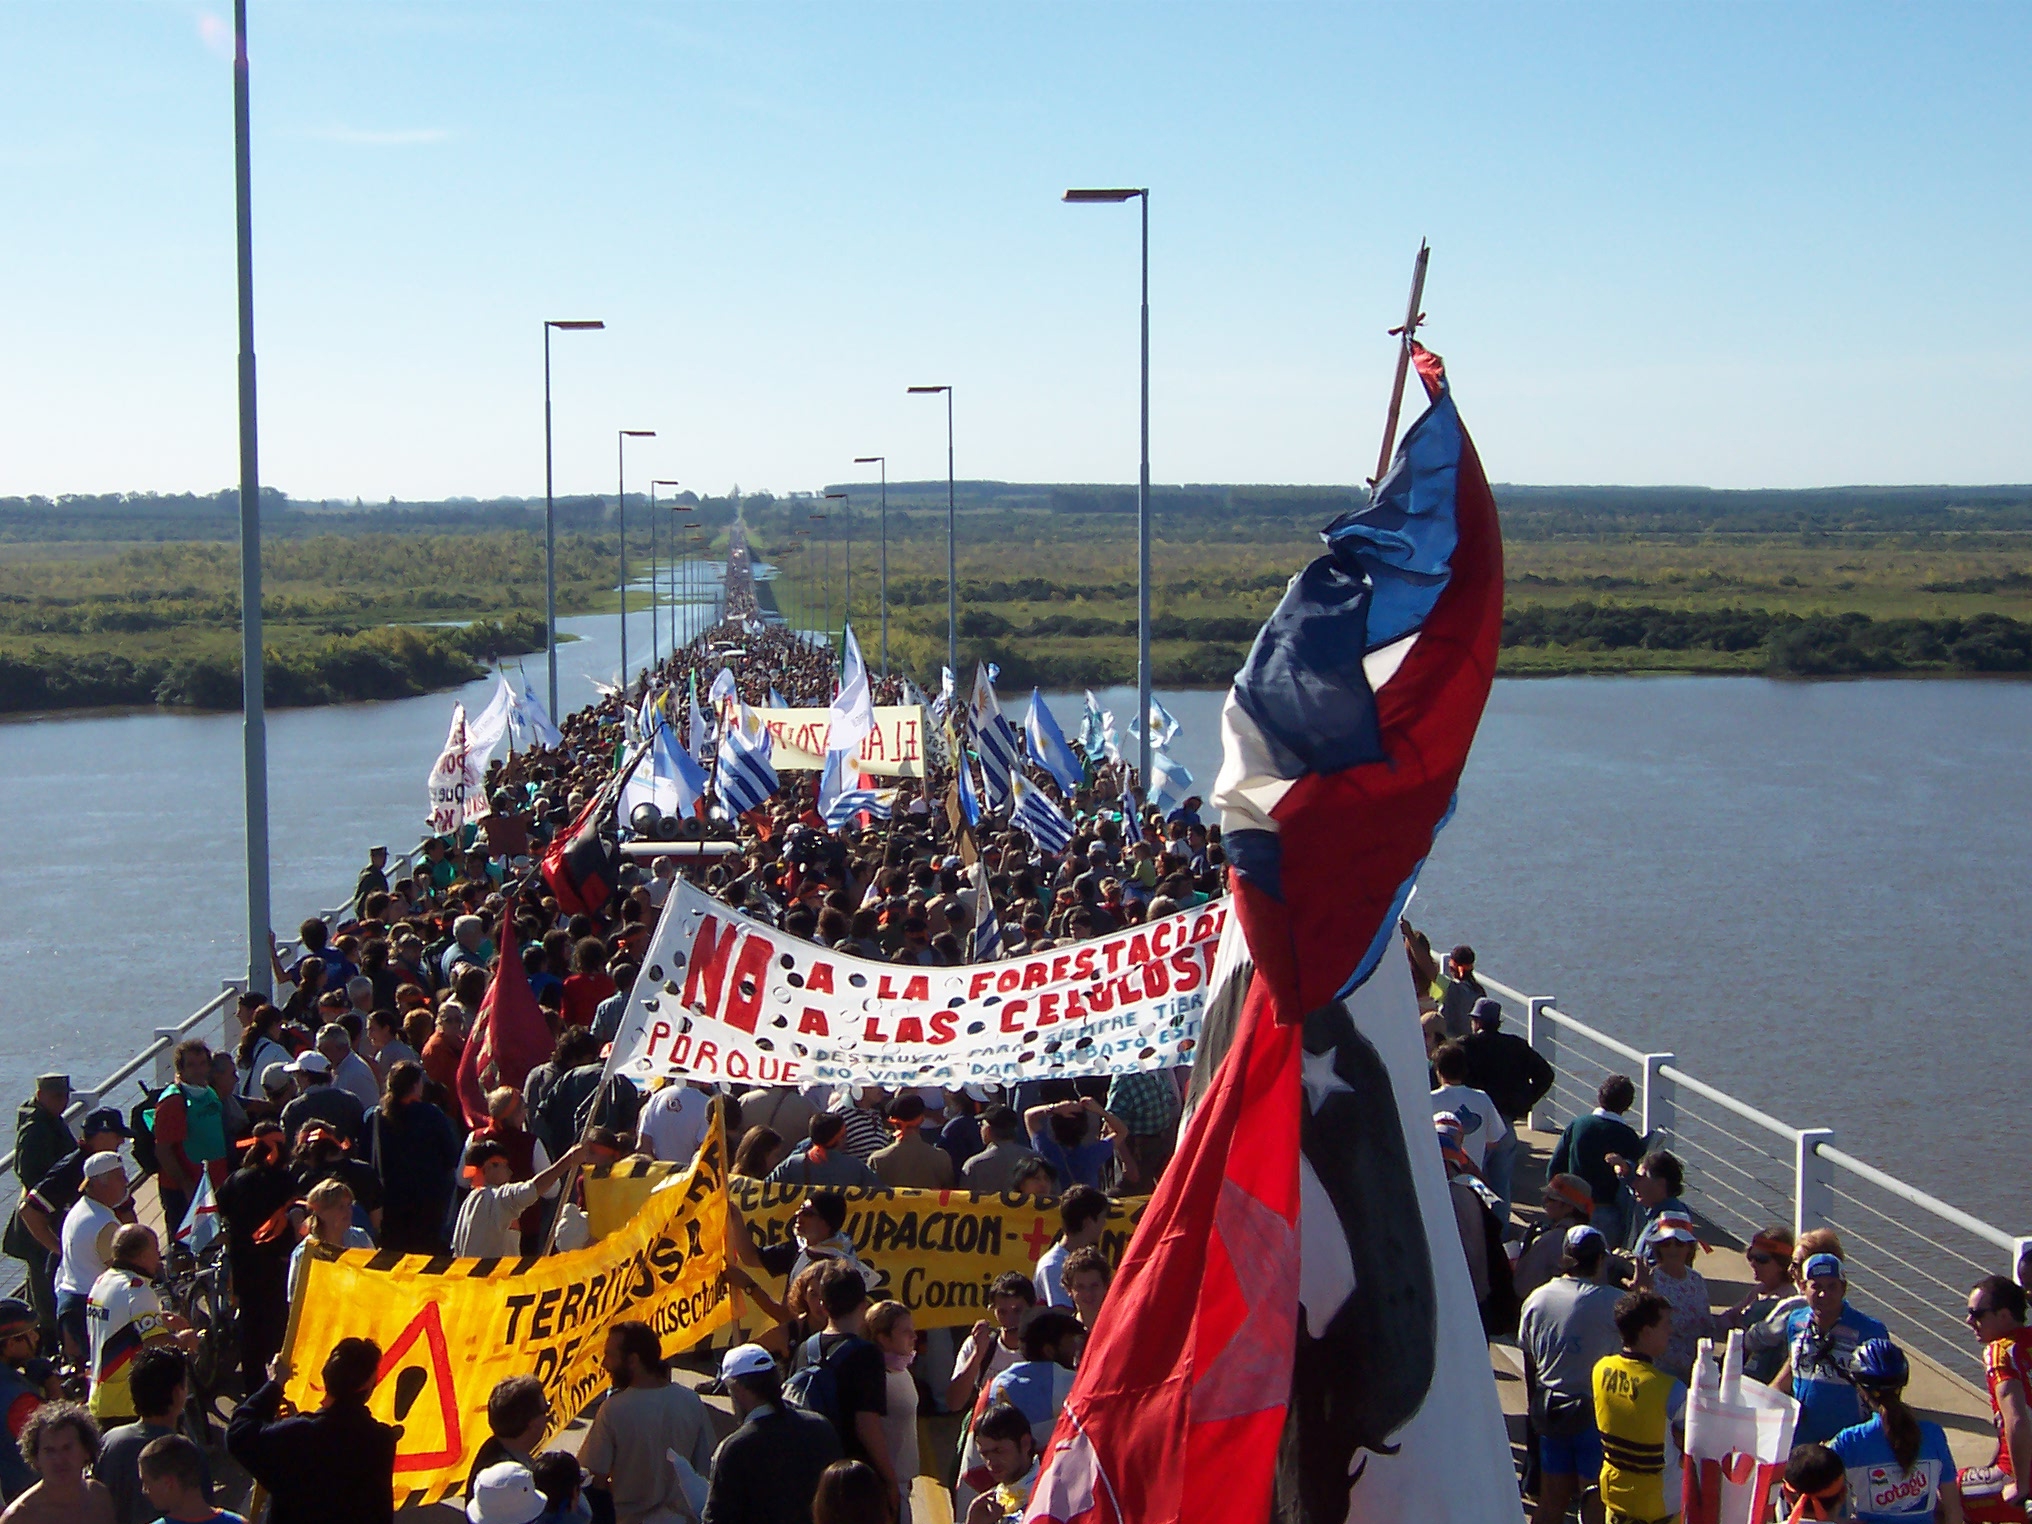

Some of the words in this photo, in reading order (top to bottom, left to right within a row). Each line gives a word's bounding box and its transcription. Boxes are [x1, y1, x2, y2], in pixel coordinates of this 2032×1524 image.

[682, 915, 774, 1035] NO
[806, 962, 834, 995] A
[878, 975, 929, 1001] LA
[799, 1006, 829, 1037] A
[863, 1008, 957, 1045] LAS
[646, 1021, 799, 1082] PORQUE
[815, 1066, 852, 1078] NO
[868, 1070, 918, 1080] VAN
